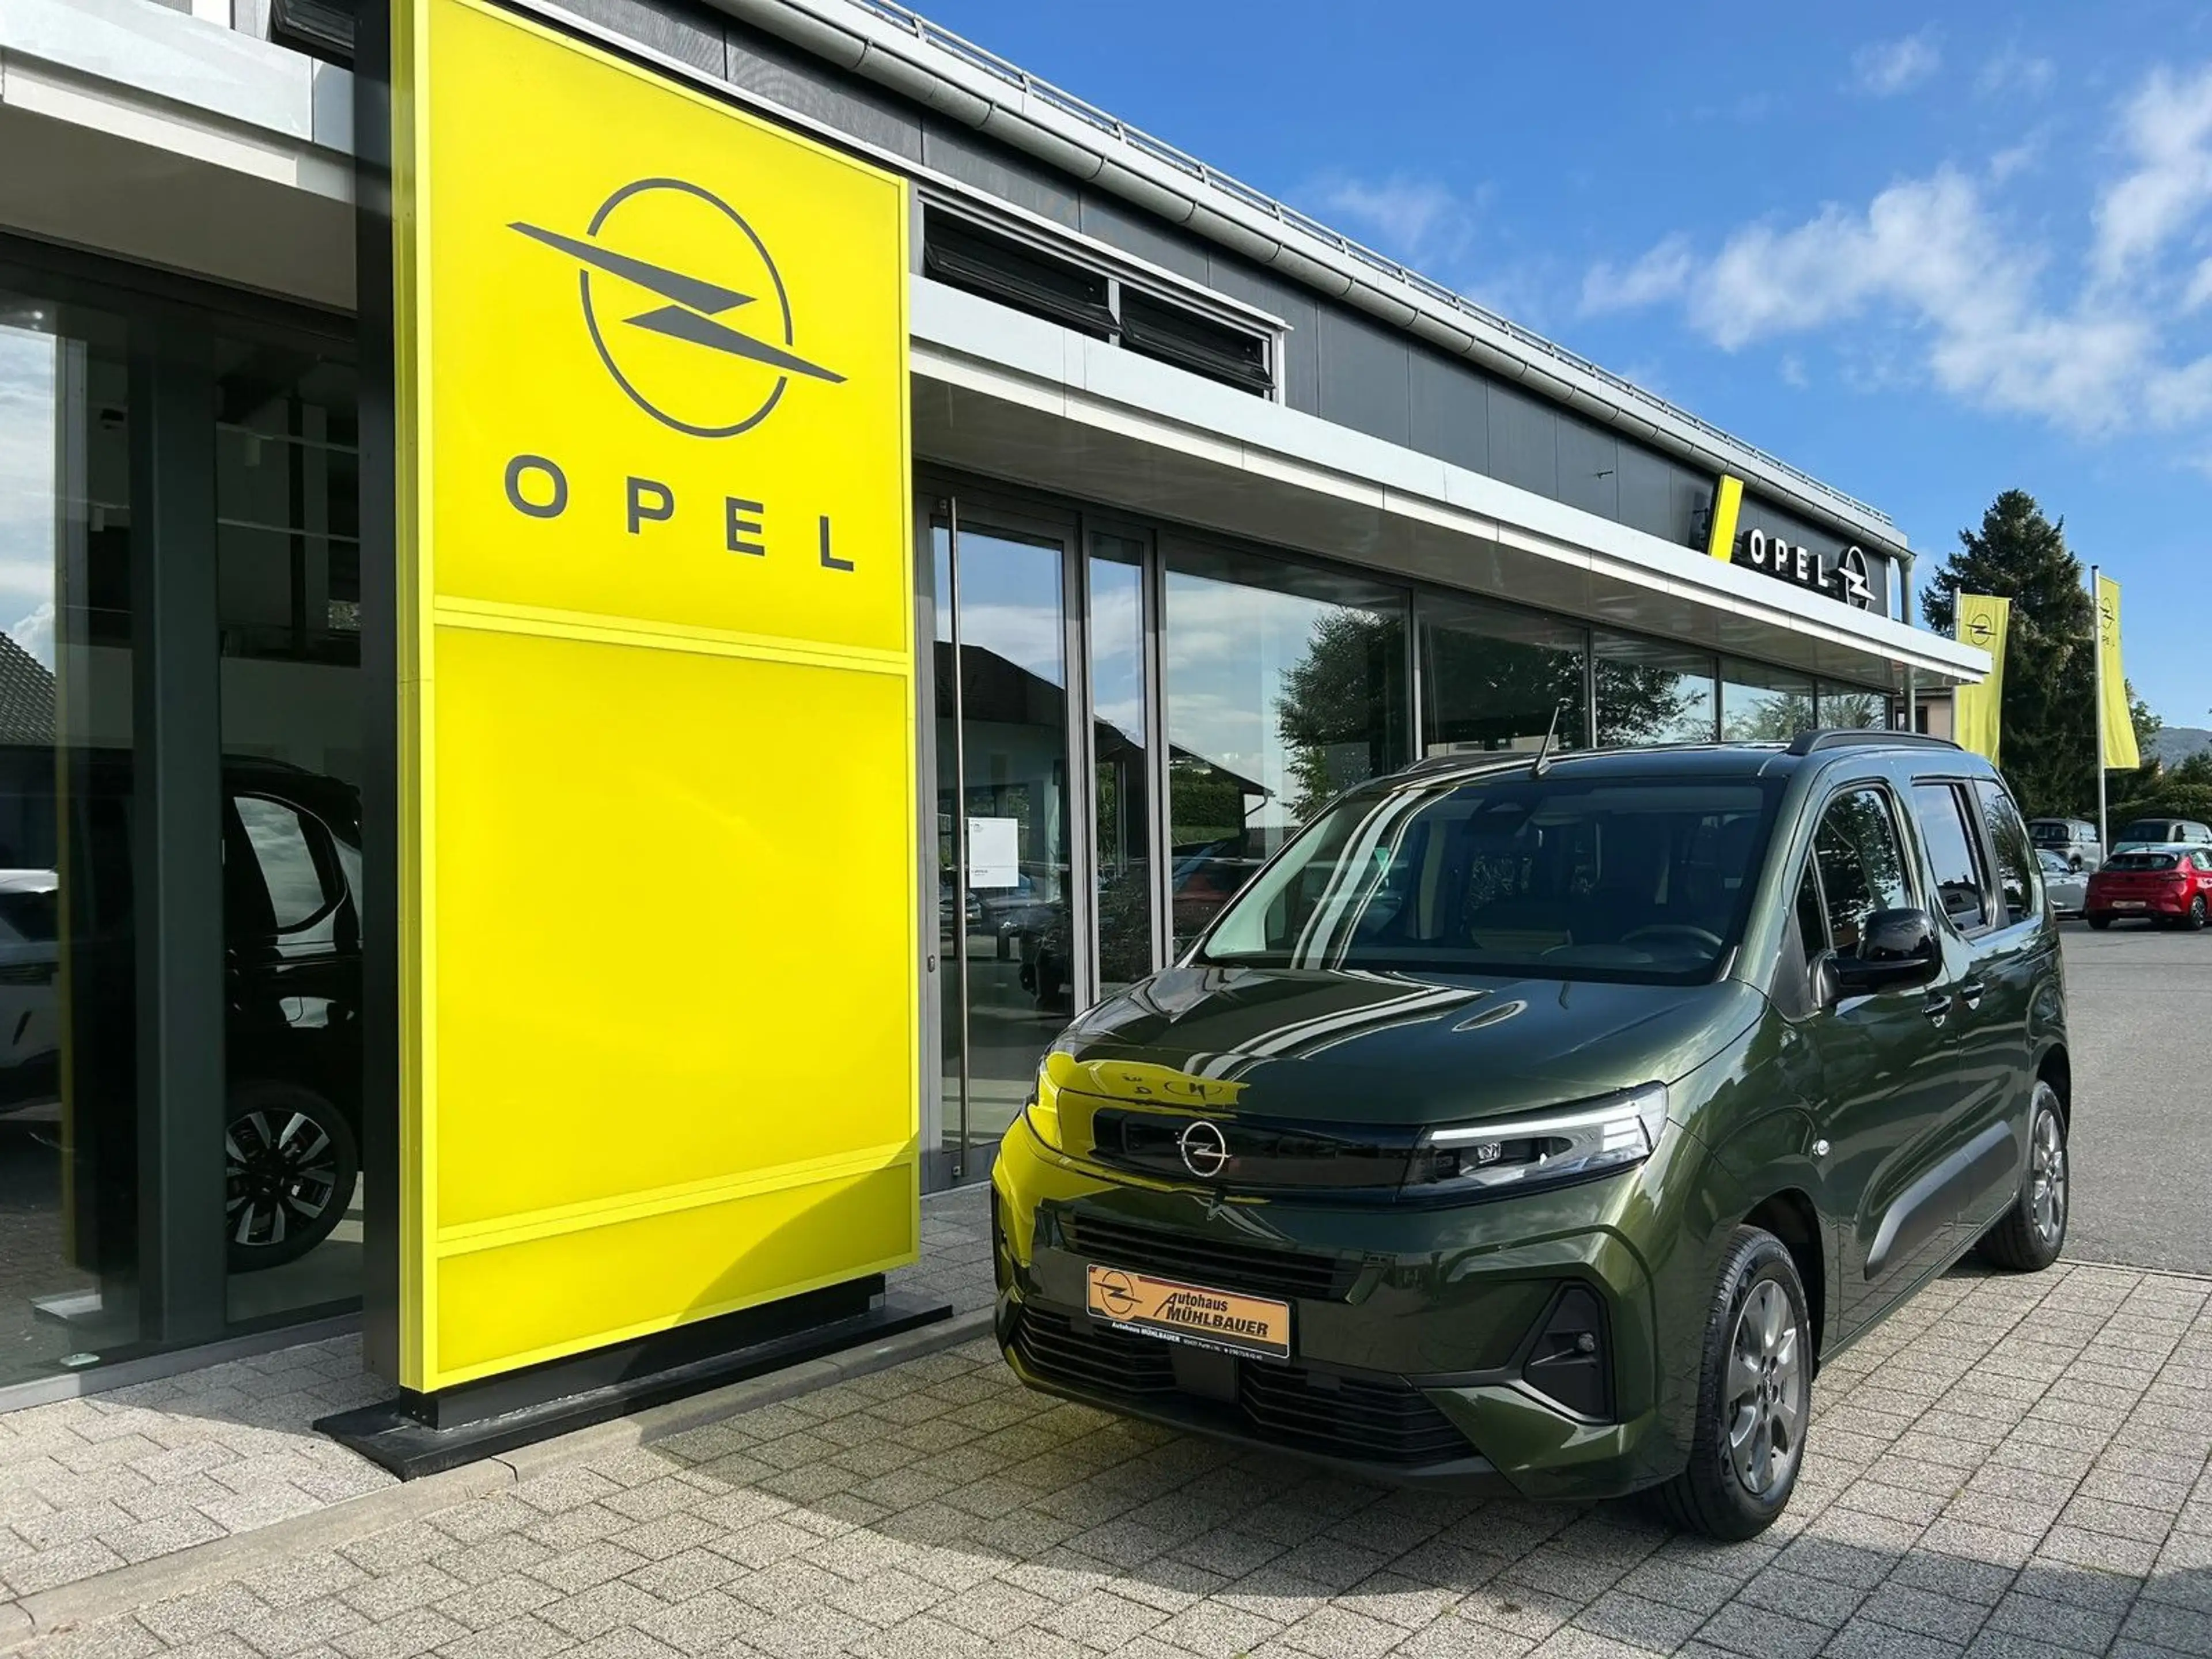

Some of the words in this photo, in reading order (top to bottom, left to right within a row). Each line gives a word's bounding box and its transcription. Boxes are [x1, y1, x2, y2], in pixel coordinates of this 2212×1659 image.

[505, 454, 854, 572] OPEL
[1750, 529, 1828, 588] OPEL
[1153, 1292, 1228, 1317] Autohaus
[1165, 1306, 1268, 1336] MÜHLBAUER
